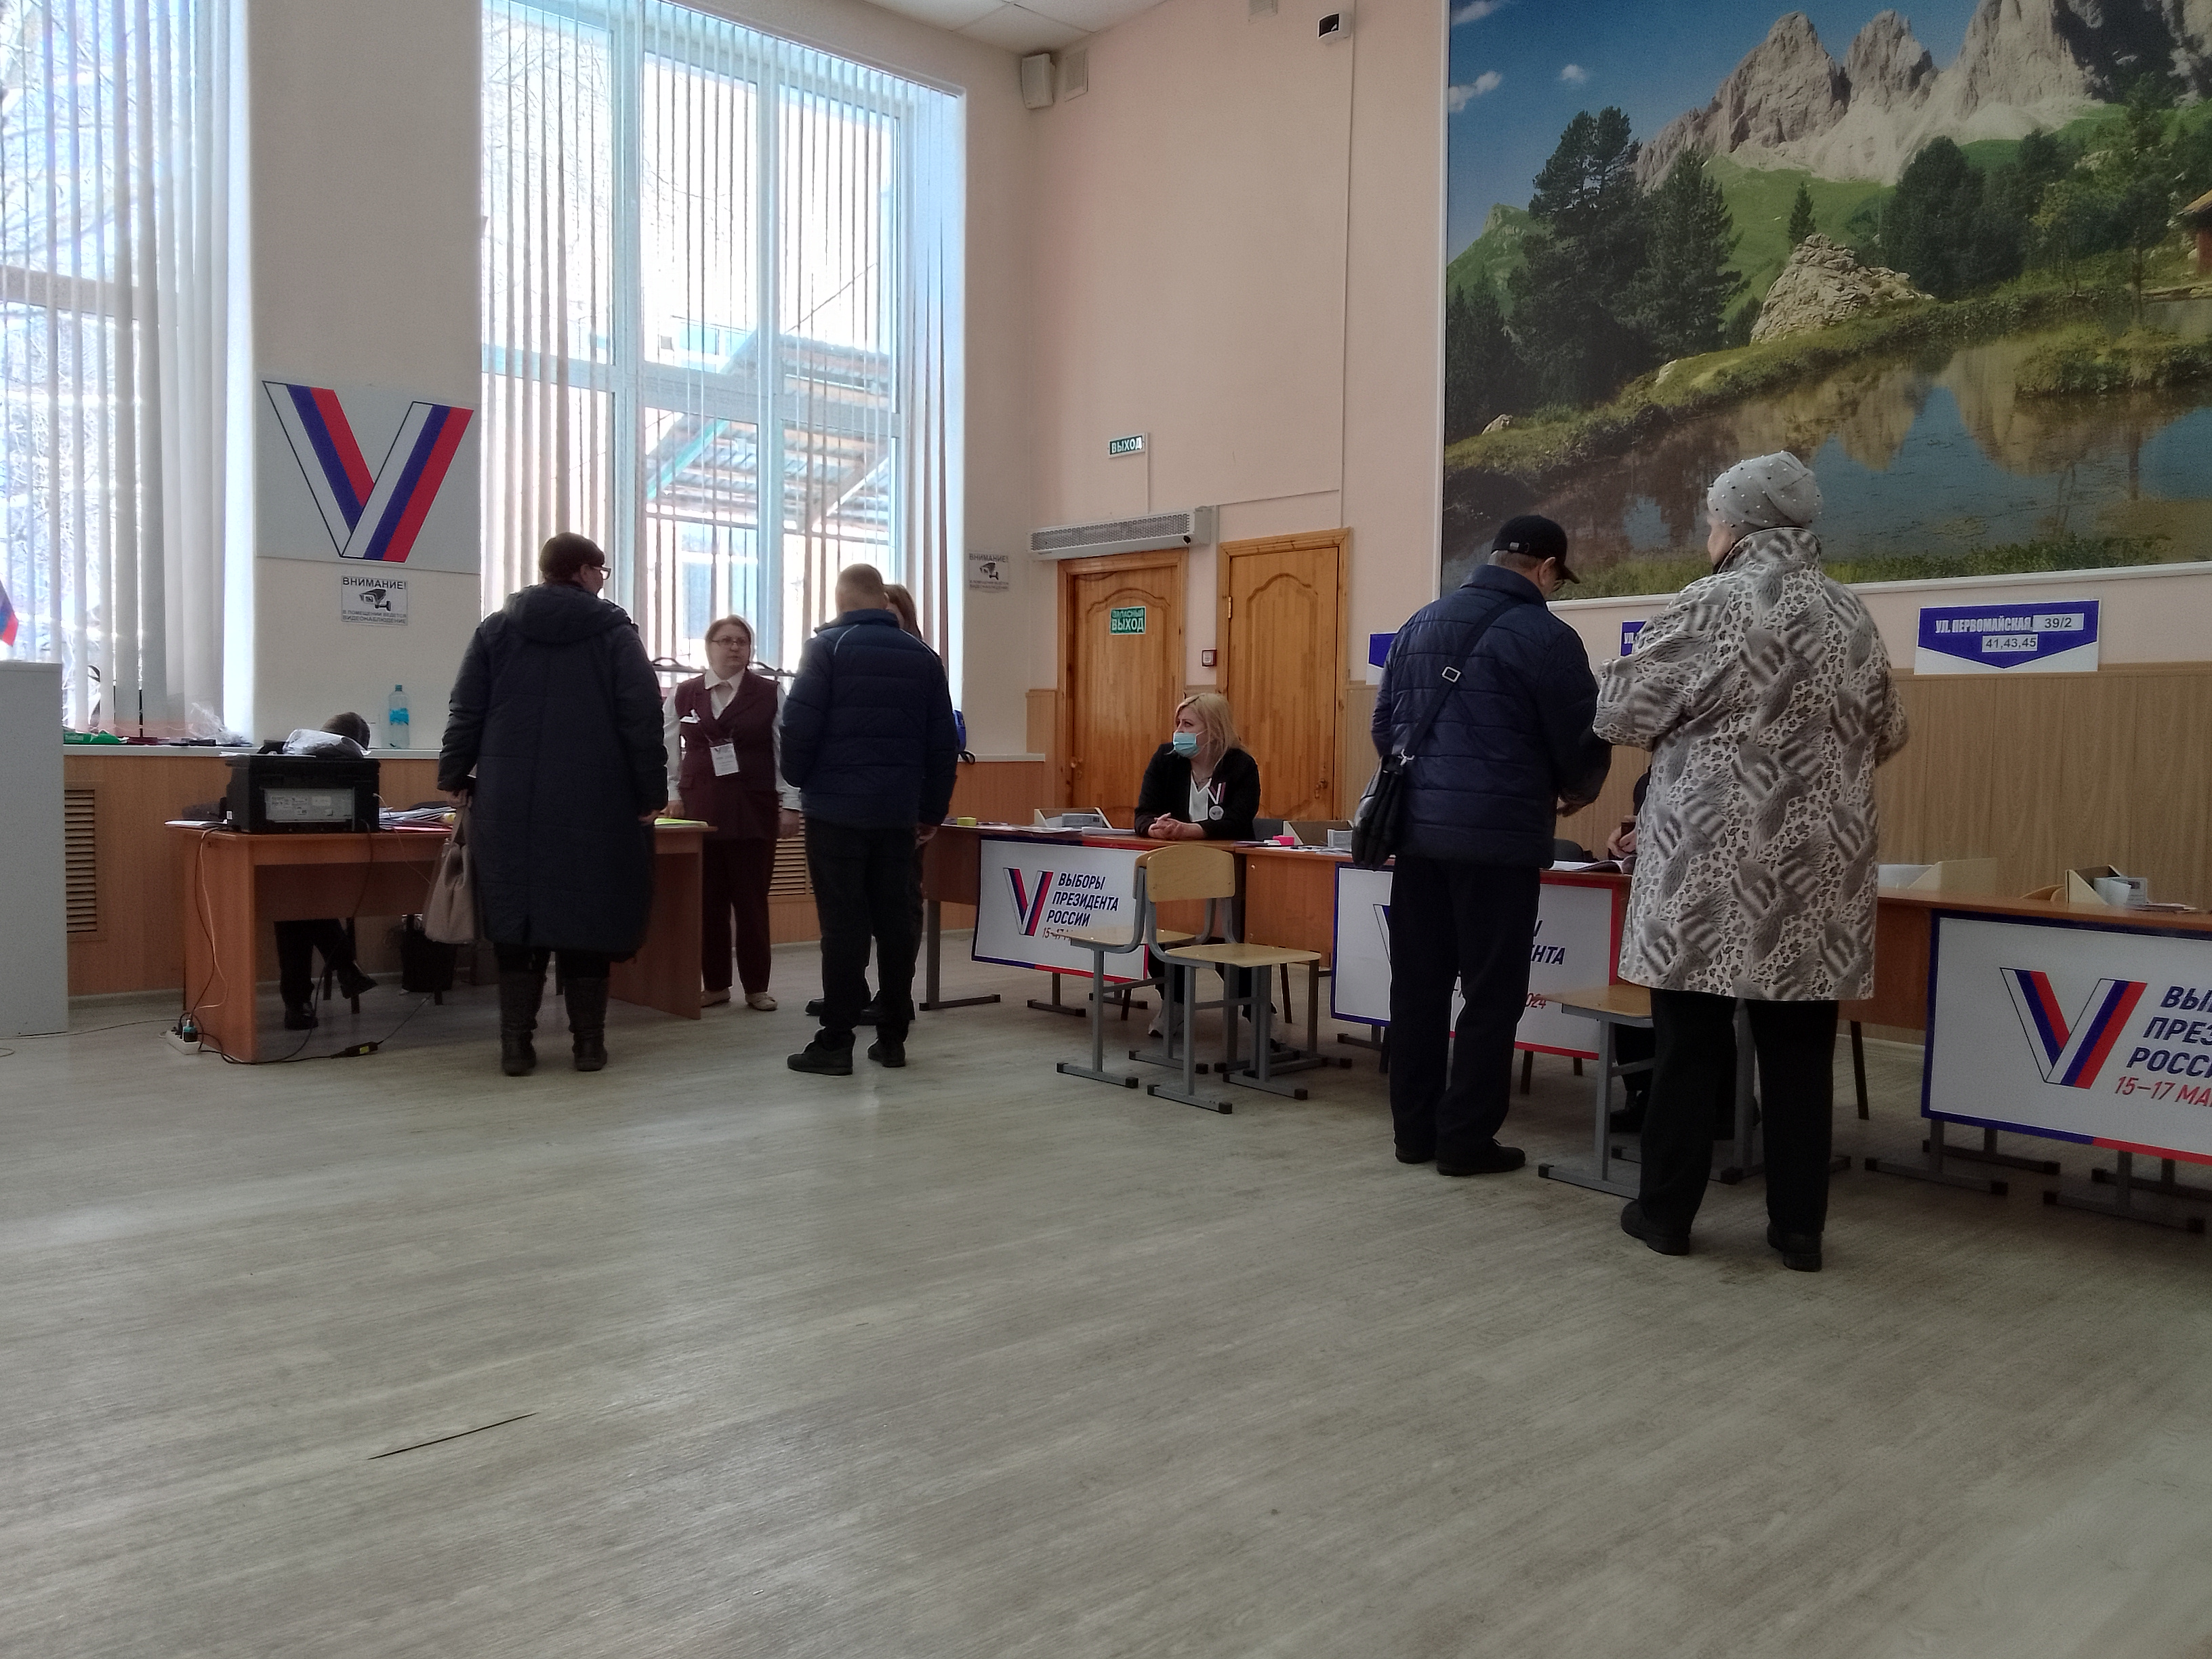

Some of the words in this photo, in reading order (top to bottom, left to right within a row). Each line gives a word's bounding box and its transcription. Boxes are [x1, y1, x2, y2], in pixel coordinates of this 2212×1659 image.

[1111, 437, 1142, 453] ВЫХОД
[343, 577, 406, 590] ВНИМАНИЕ!
[343, 615, 406, 623] ВИДЕОНАБЛЮДЕНИЕ
[1112, 618, 1143, 632] ВЫХОД
[1936, 619, 1950, 633] УЛ.
[2044, 617, 2072, 628] 39/2
[1986, 638, 2036, 649] 41,43,45
[1058, 873, 1105, 890] ВЫБОРЫ
[1052, 891, 1119, 911] ПРЕЗИДЕНТА
[1046, 909, 1090, 927] РОССИИ
[2160, 986, 2212, 1012] ВЫ
[2175, 1084, 2212, 1107] МА
